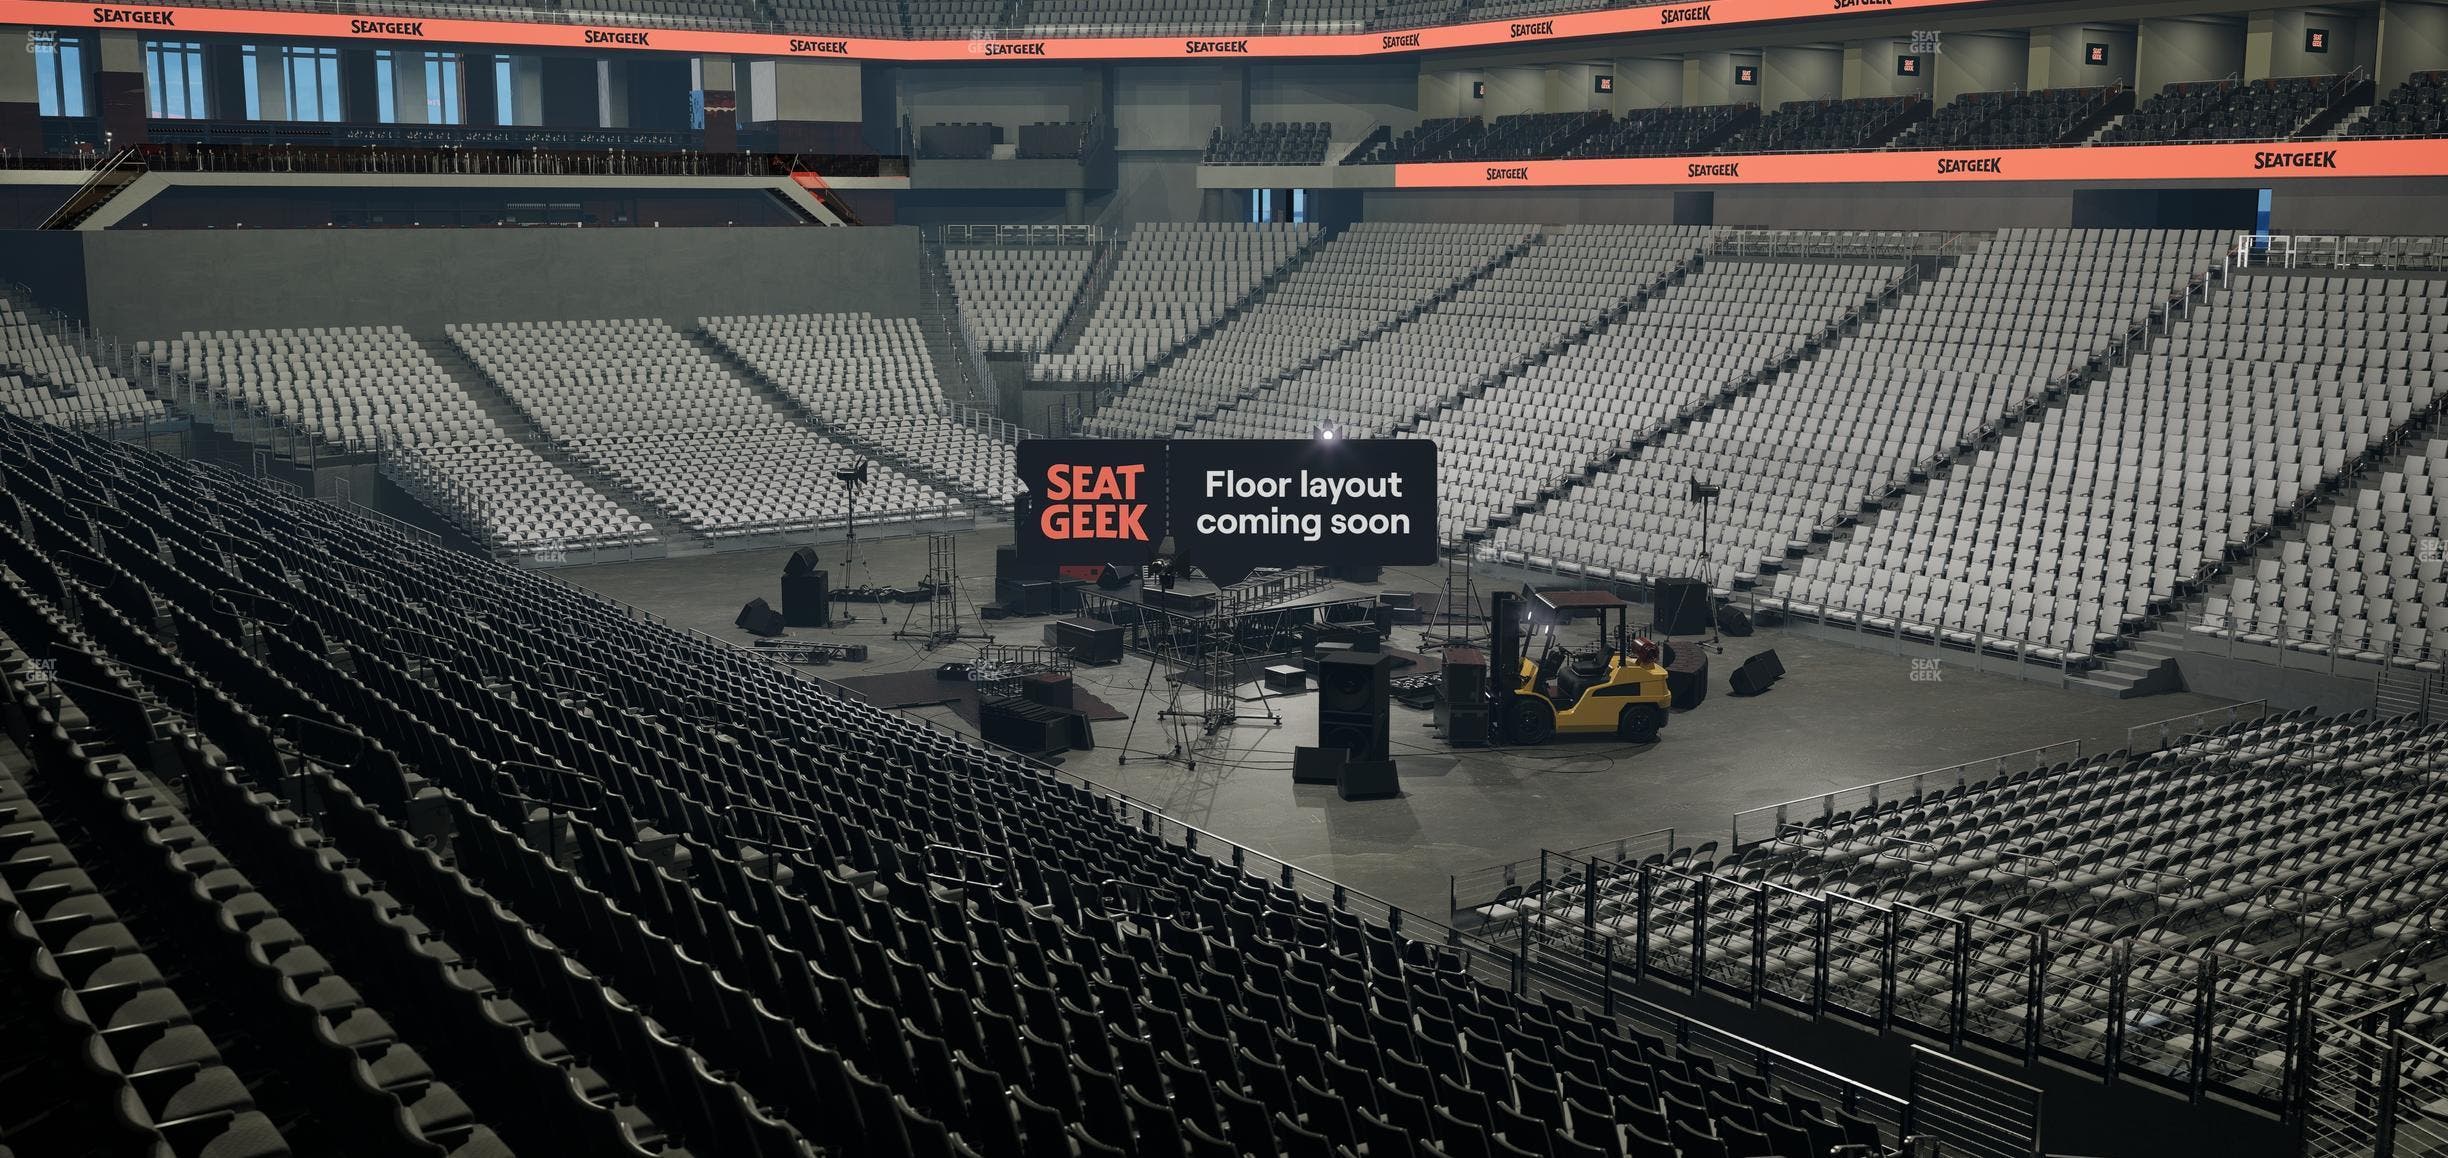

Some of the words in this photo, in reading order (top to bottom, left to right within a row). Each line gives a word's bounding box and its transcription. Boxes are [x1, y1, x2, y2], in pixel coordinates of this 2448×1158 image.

[93, 7, 175, 26] SEATGEEK
[1661, 6, 1711, 25] SEATGEEK
[351, 19, 424, 37] SEATGEEK
[1510, 21, 1553, 38] SEATGEEK
[584, 29, 649, 46] SEATGEEK
[1382, 34, 1420, 50] SEATGEEK
[789, 39, 848, 54] SEATGEEK
[984, 43, 1045, 56] SEATGEEK
[1186, 40, 1248, 54] SEATGEEK
[1937, 157, 2001, 174] SEATGEEK
[2254, 150, 2337, 170] SEATGEEK
[1486, 167, 1528, 181] SEATGEEK
[1688, 162, 1739, 178] SEATGEEK
[1047, 463, 1145, 500] SEAT
[1206, 470, 1292, 498] Floor
[1300, 470, 1403, 505] layout
[1040, 504, 1149, 541] GEEK
[1196, 506, 1322, 542] coming
[1330, 513, 1410, 535] soon
